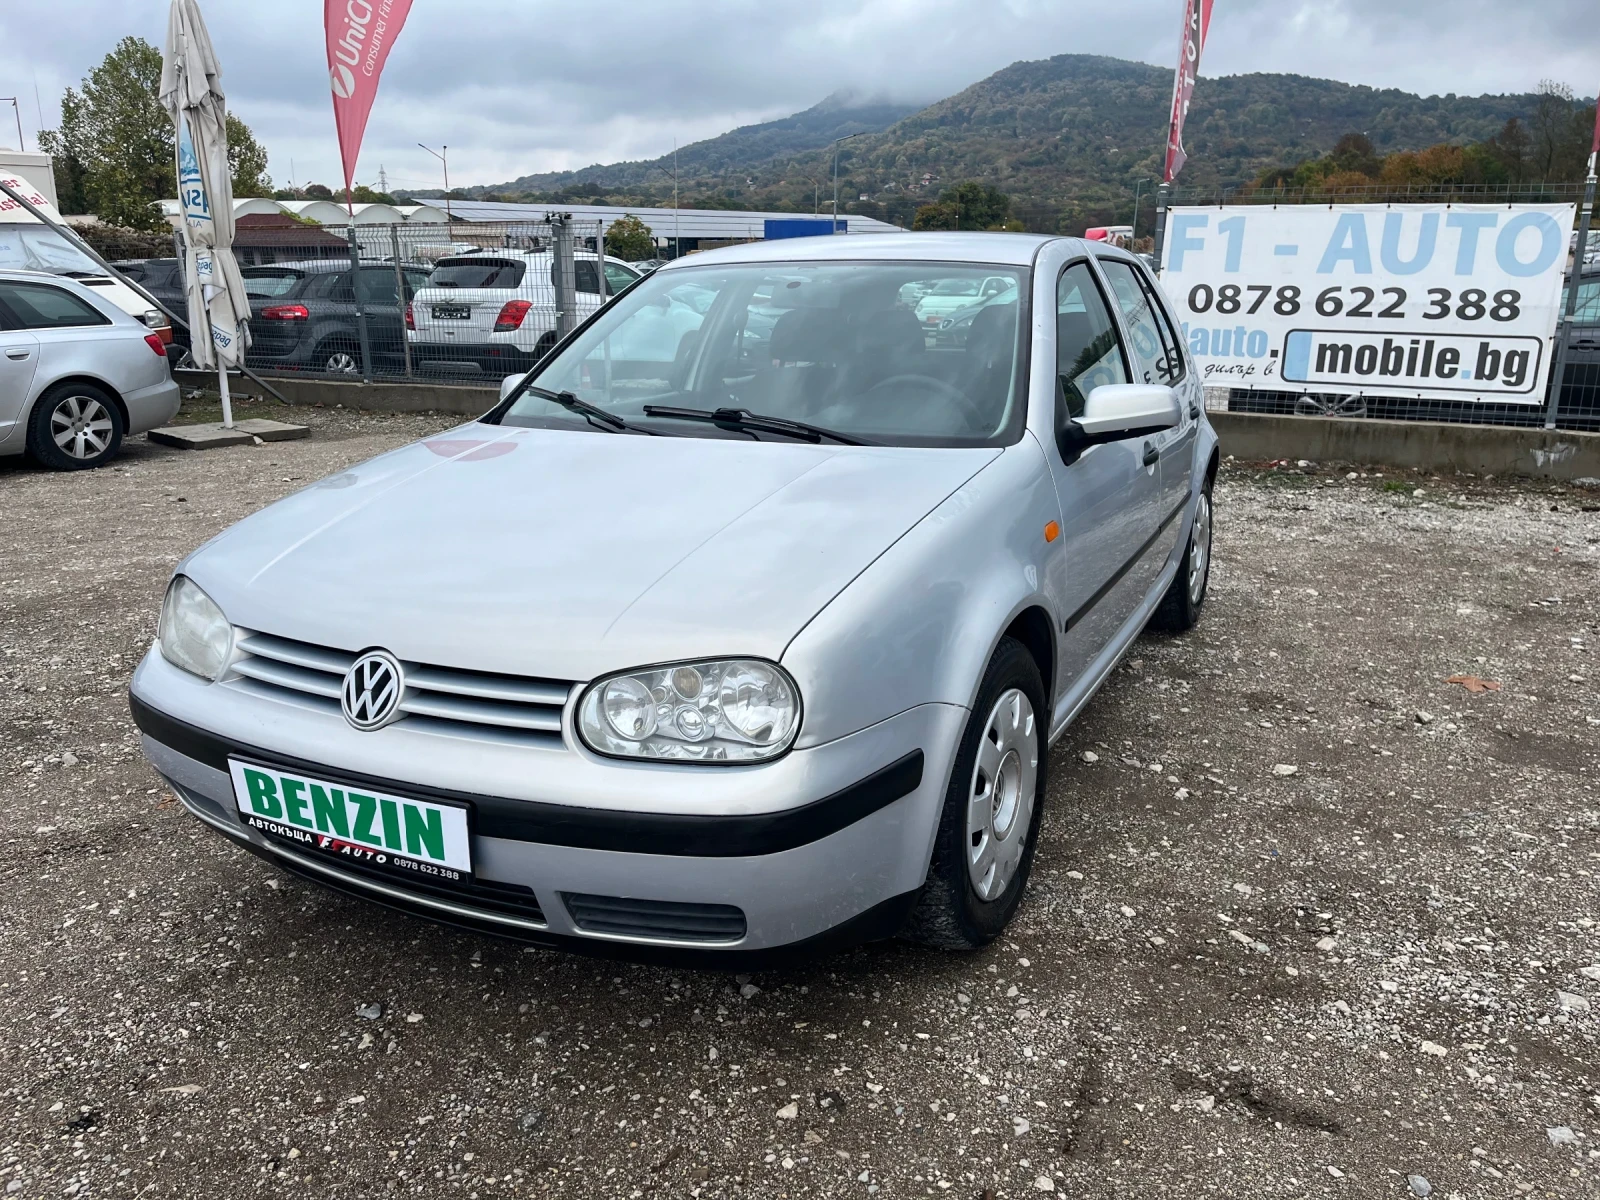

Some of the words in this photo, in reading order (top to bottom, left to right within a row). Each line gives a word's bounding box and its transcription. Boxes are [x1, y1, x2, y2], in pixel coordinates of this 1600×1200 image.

[362, 17, 387, 77] Consumer
[1167, 214, 1246, 272] F1
[1315, 211, 1562, 278] AUTO
[1187, 283, 1301, 316] 0878
[1315, 286, 1407, 319] 622
[1421, 287, 1521, 322] 388
[1315, 338, 1530, 387] mobile.bg
[243, 767, 445, 861] BENZIN
[248, 816, 313, 844] АВТОКЪЩА
[341, 845, 387, 864] AUTO
[393, 857, 419, 871] 0878
[420, 863, 439, 876] 622
[440, 868, 460, 881] 388
